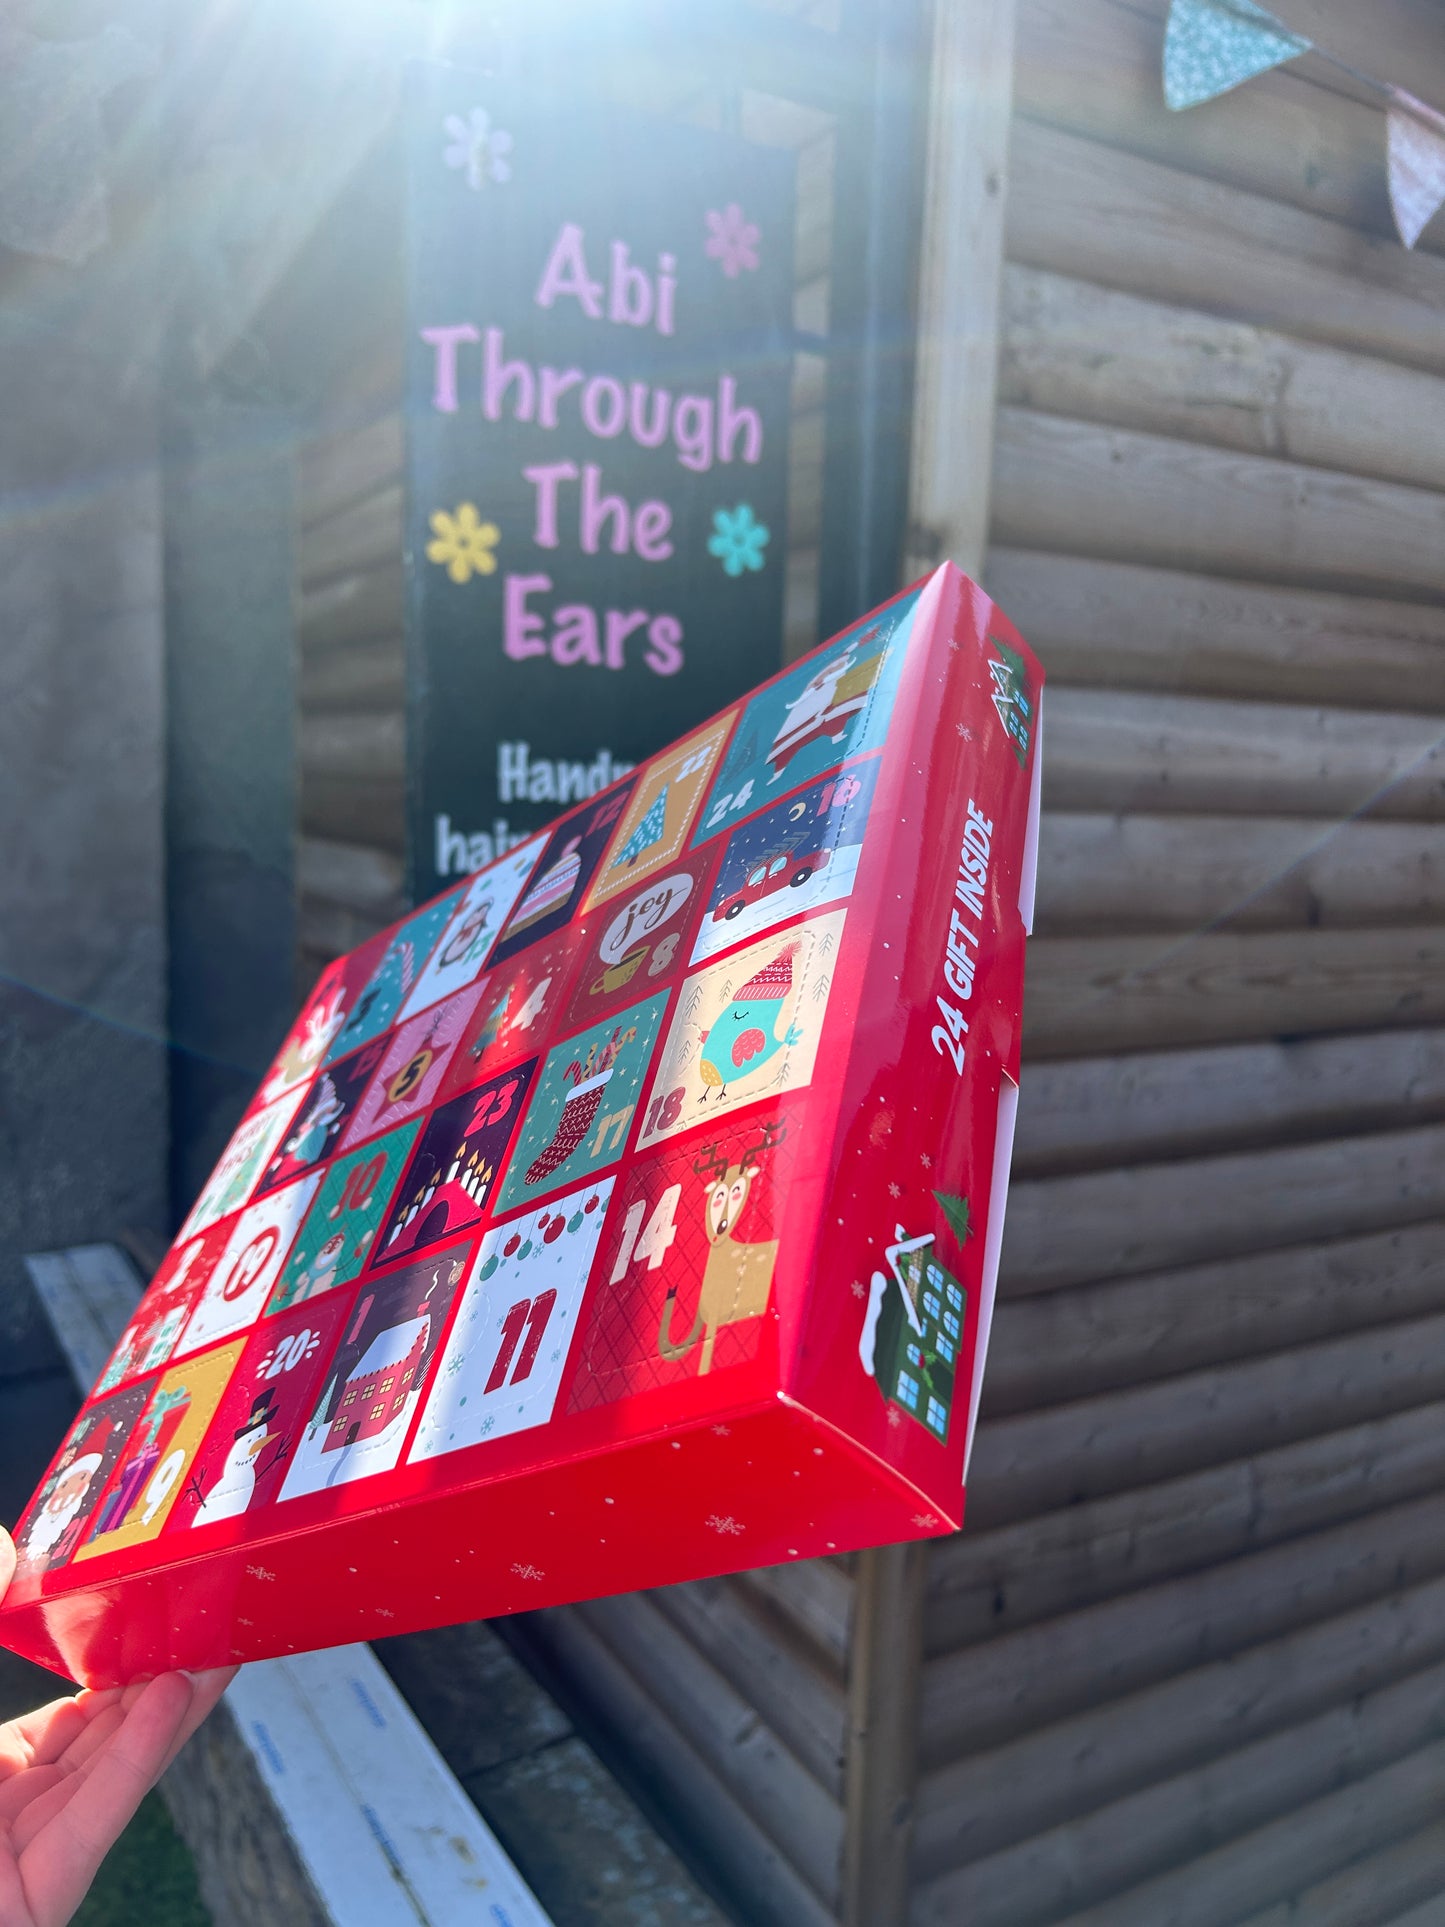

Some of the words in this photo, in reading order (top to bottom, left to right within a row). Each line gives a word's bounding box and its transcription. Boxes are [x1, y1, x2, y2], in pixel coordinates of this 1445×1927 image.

[535, 222, 676, 336] Abi
[419, 323, 763, 471] Through
[522, 460, 673, 561] The
[503, 573, 683, 675] Ears
[675, 746, 711, 783] 22
[585, 791, 630, 838] 12
[706, 779, 754, 829] 24
[816, 774, 861, 817] 16
[955, 798, 993, 921] INSIDE
[610, 888, 688, 951] joy
[647, 932, 680, 977] 8
[944, 908, 979, 1000] GIFT
[511, 977, 552, 1030] 4
[931, 995, 969, 1076] 24
[394, 1054, 427, 1098] 5
[464, 1080, 519, 1137] 23
[590, 1104, 634, 1158] 17
[642, 1086, 685, 1139] 18
[330, 1151, 388, 1221] 10
[609, 1183, 682, 1286] 14
[226, 1236, 274, 1295] 19
[346, 1294, 375, 1345] 1
[483, 1288, 557, 1395] 11
[265, 1329, 312, 1380] 20
[142, 1449, 185, 1526] 9
[51, 1515, 89, 1560] 21
